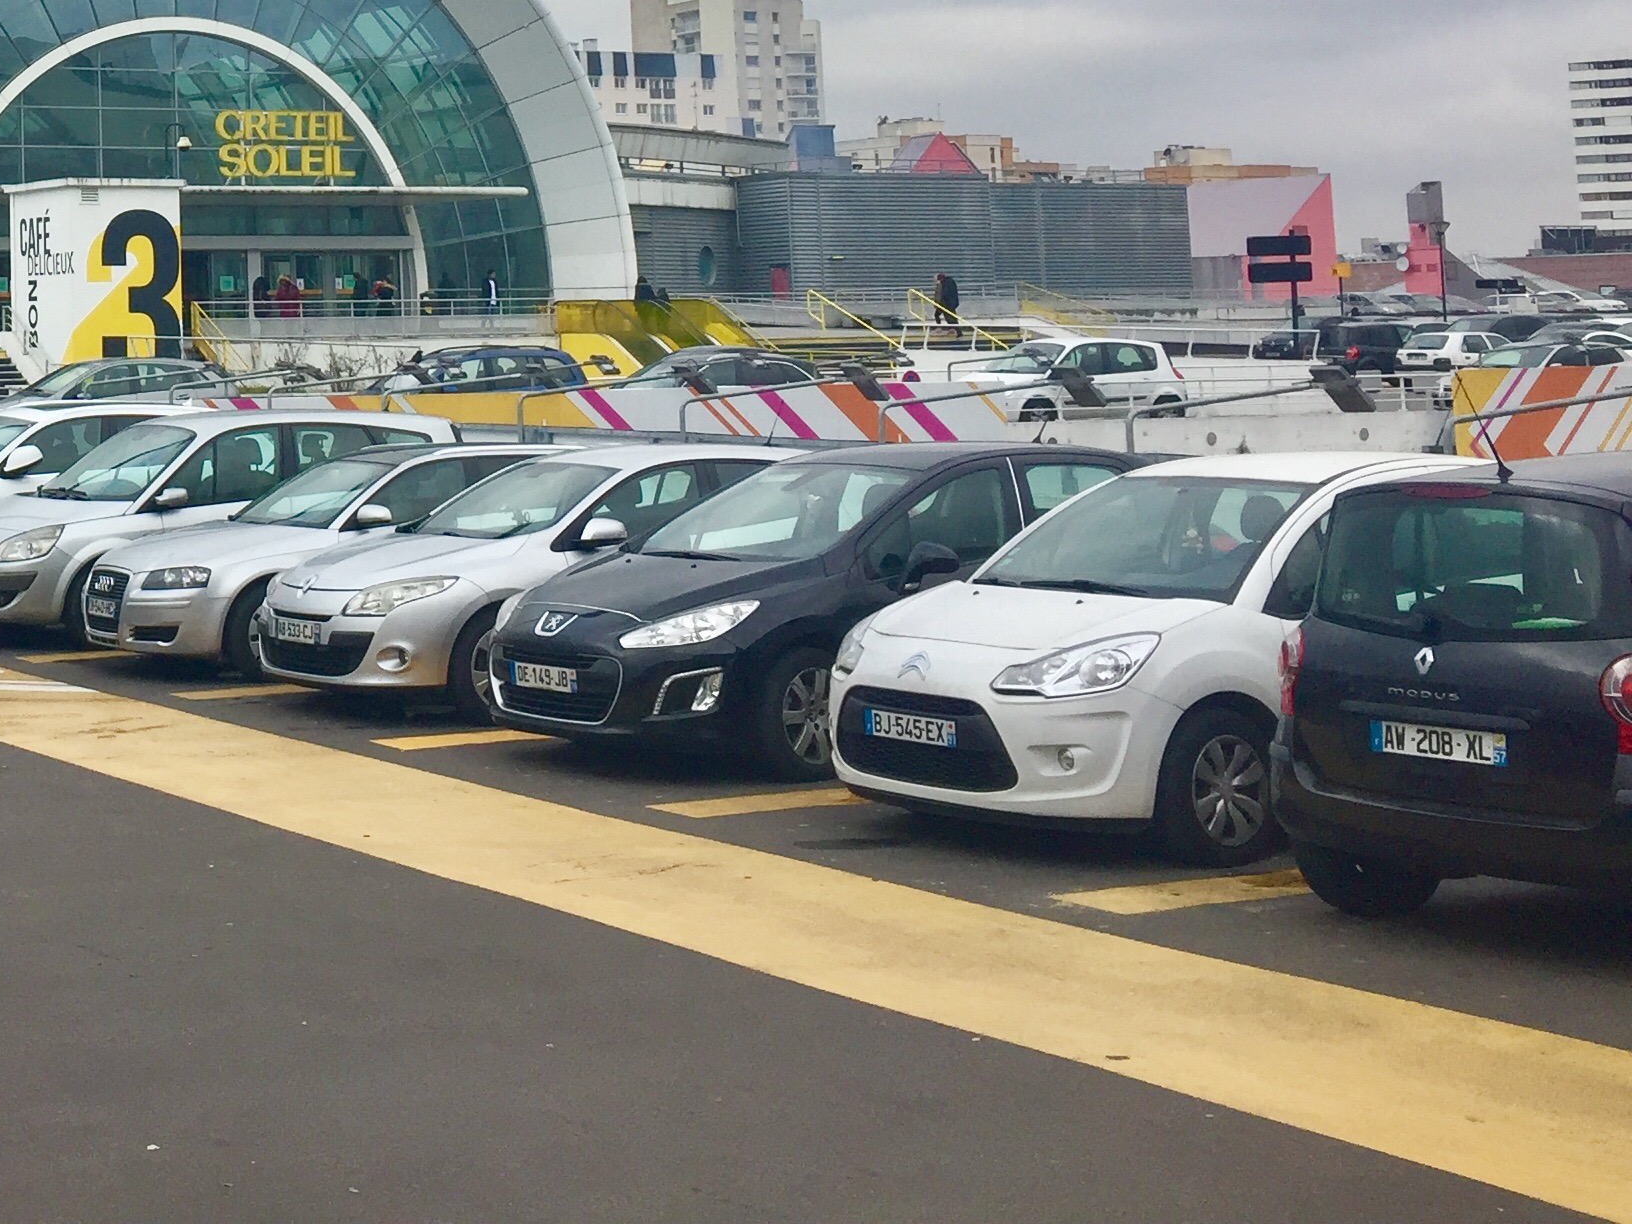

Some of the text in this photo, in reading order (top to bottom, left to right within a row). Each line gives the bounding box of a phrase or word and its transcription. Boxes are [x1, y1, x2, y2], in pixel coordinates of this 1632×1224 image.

[215, 109, 355, 142] CRETEIL
[219, 143, 356, 177] SOLEIL
[20, 209, 51, 256] CAFÉ
[517, 665, 568, 687] DE-149-JB
[1493, 750, 1506, 763] 57
